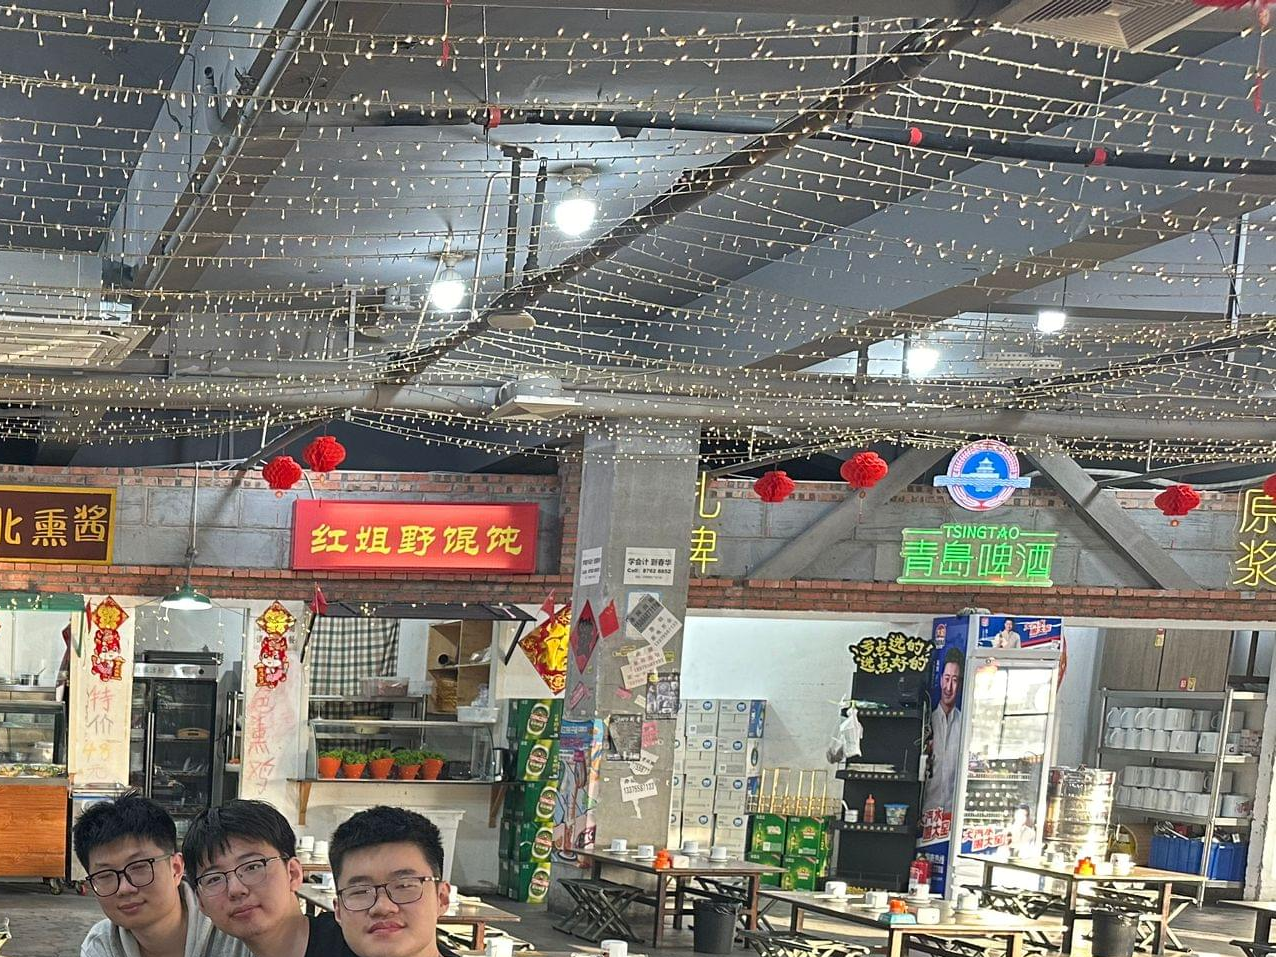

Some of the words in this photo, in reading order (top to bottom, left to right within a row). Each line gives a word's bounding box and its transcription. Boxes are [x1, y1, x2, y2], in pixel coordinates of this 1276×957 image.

[310, 523, 524, 556] 红姐野馄饨
[943, 525, 1020, 540] TSINGTAO
